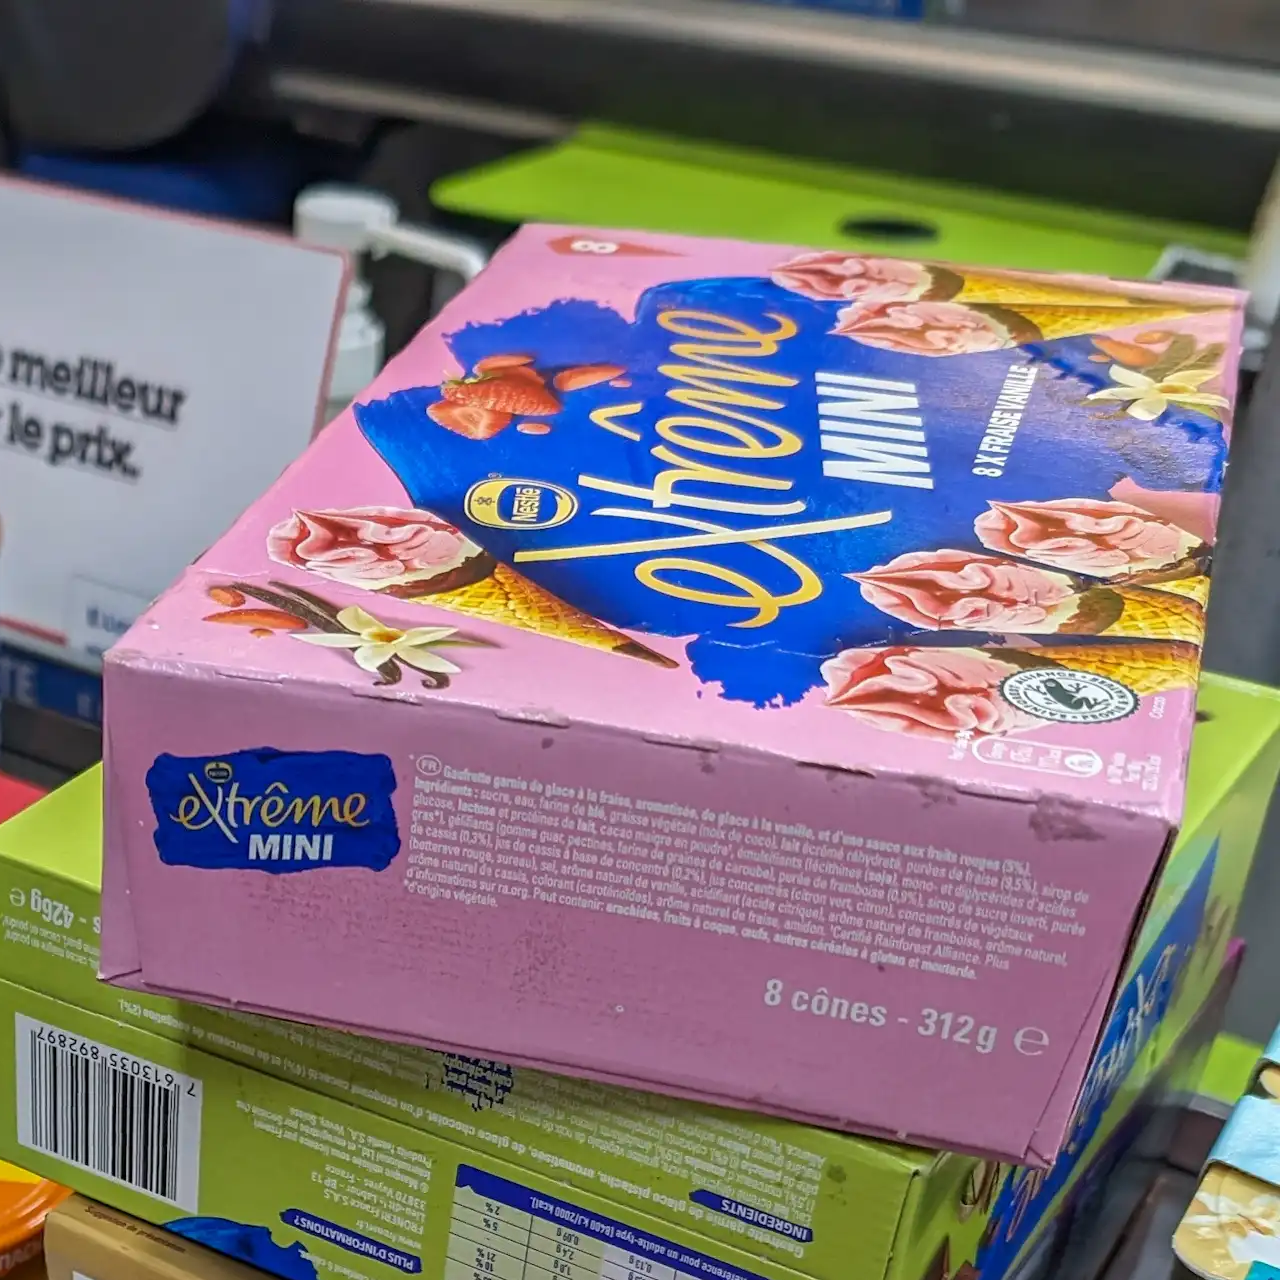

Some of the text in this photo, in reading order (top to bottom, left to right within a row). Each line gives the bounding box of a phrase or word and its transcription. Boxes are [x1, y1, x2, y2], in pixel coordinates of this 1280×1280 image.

[10, 344, 185, 425] meilleur
[10, 400, 43, 448] le
[47, 419, 142, 479] prix.
[814, 371, 933, 489] MINI
[971, 363, 1038, 477] 8 X FRAISE VANILLE
[511, 487, 541, 521] Nestlé
[248, 833, 334, 861] MINI
[764, 979, 783, 1006] 8
[791, 986, 887, 1028] cônes
[36, 1027, 196, 1097] 7 613035 892897
[293, 1213, 413, 1270] PLUS D'INFORMATIONS?
[614, 1226, 665, 1258] adulte-type
[718, 1197, 808, 1239] INGREDIENTS
[665, 1247, 678, 1260] un
[677, 1249, 701, 1270] pour
